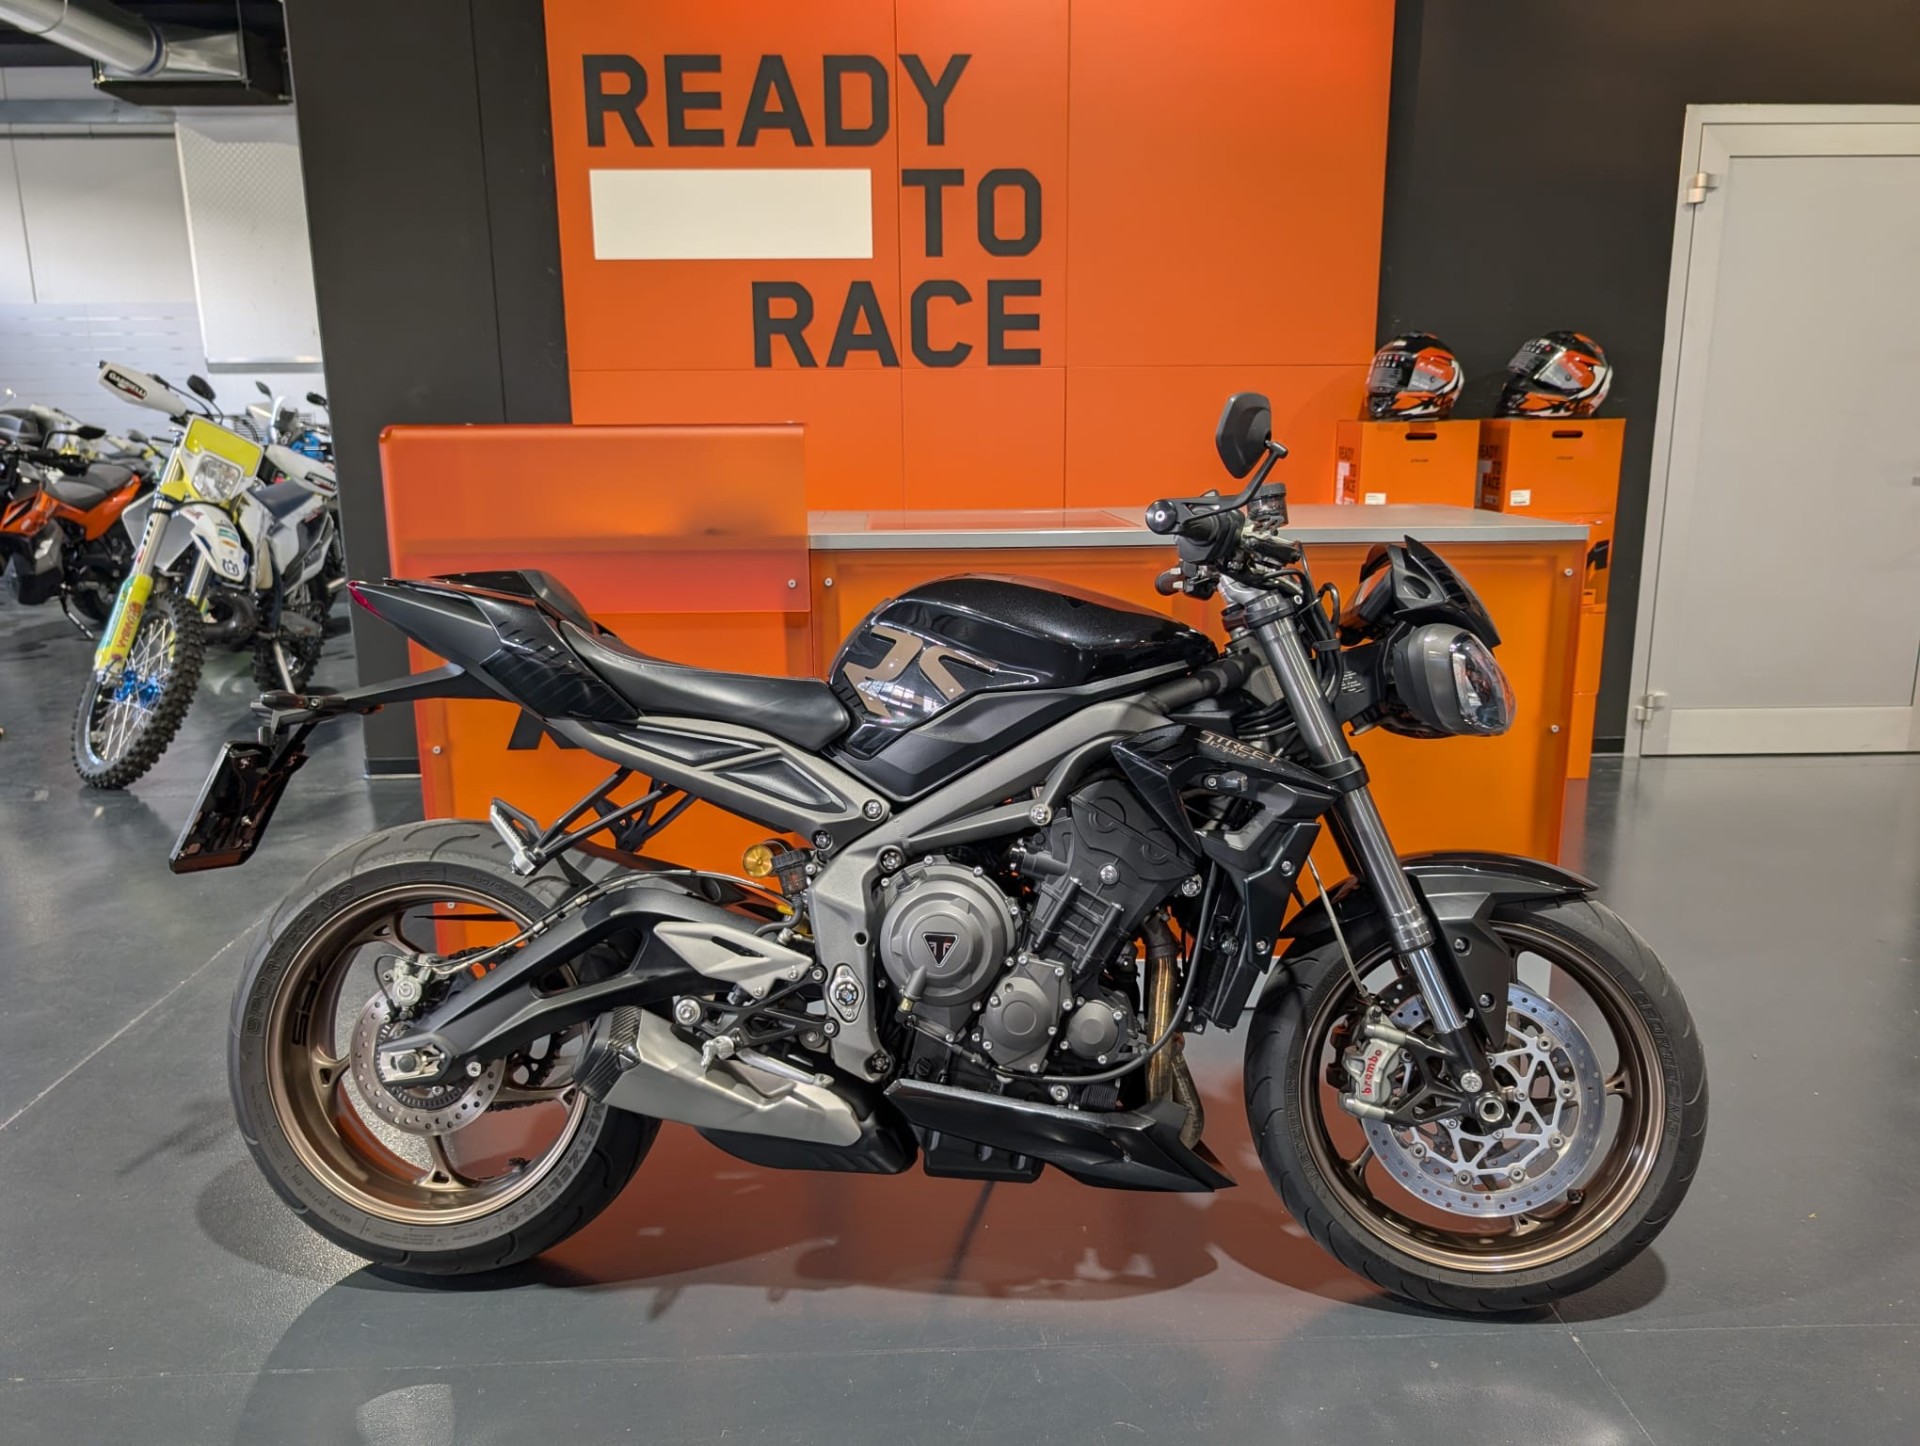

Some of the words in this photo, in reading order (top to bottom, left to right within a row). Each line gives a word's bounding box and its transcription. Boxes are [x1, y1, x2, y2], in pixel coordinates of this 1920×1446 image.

[582, 54, 973, 148] READY
[902, 168, 1043, 258] TO
[751, 279, 1043, 368] RACE
[1194, 729, 1281, 764] STREET
[246, 910, 316, 1035] SPORTEC
[1361, 1049, 1382, 1094] brembo
[522, 1104, 605, 1216] METZELER
